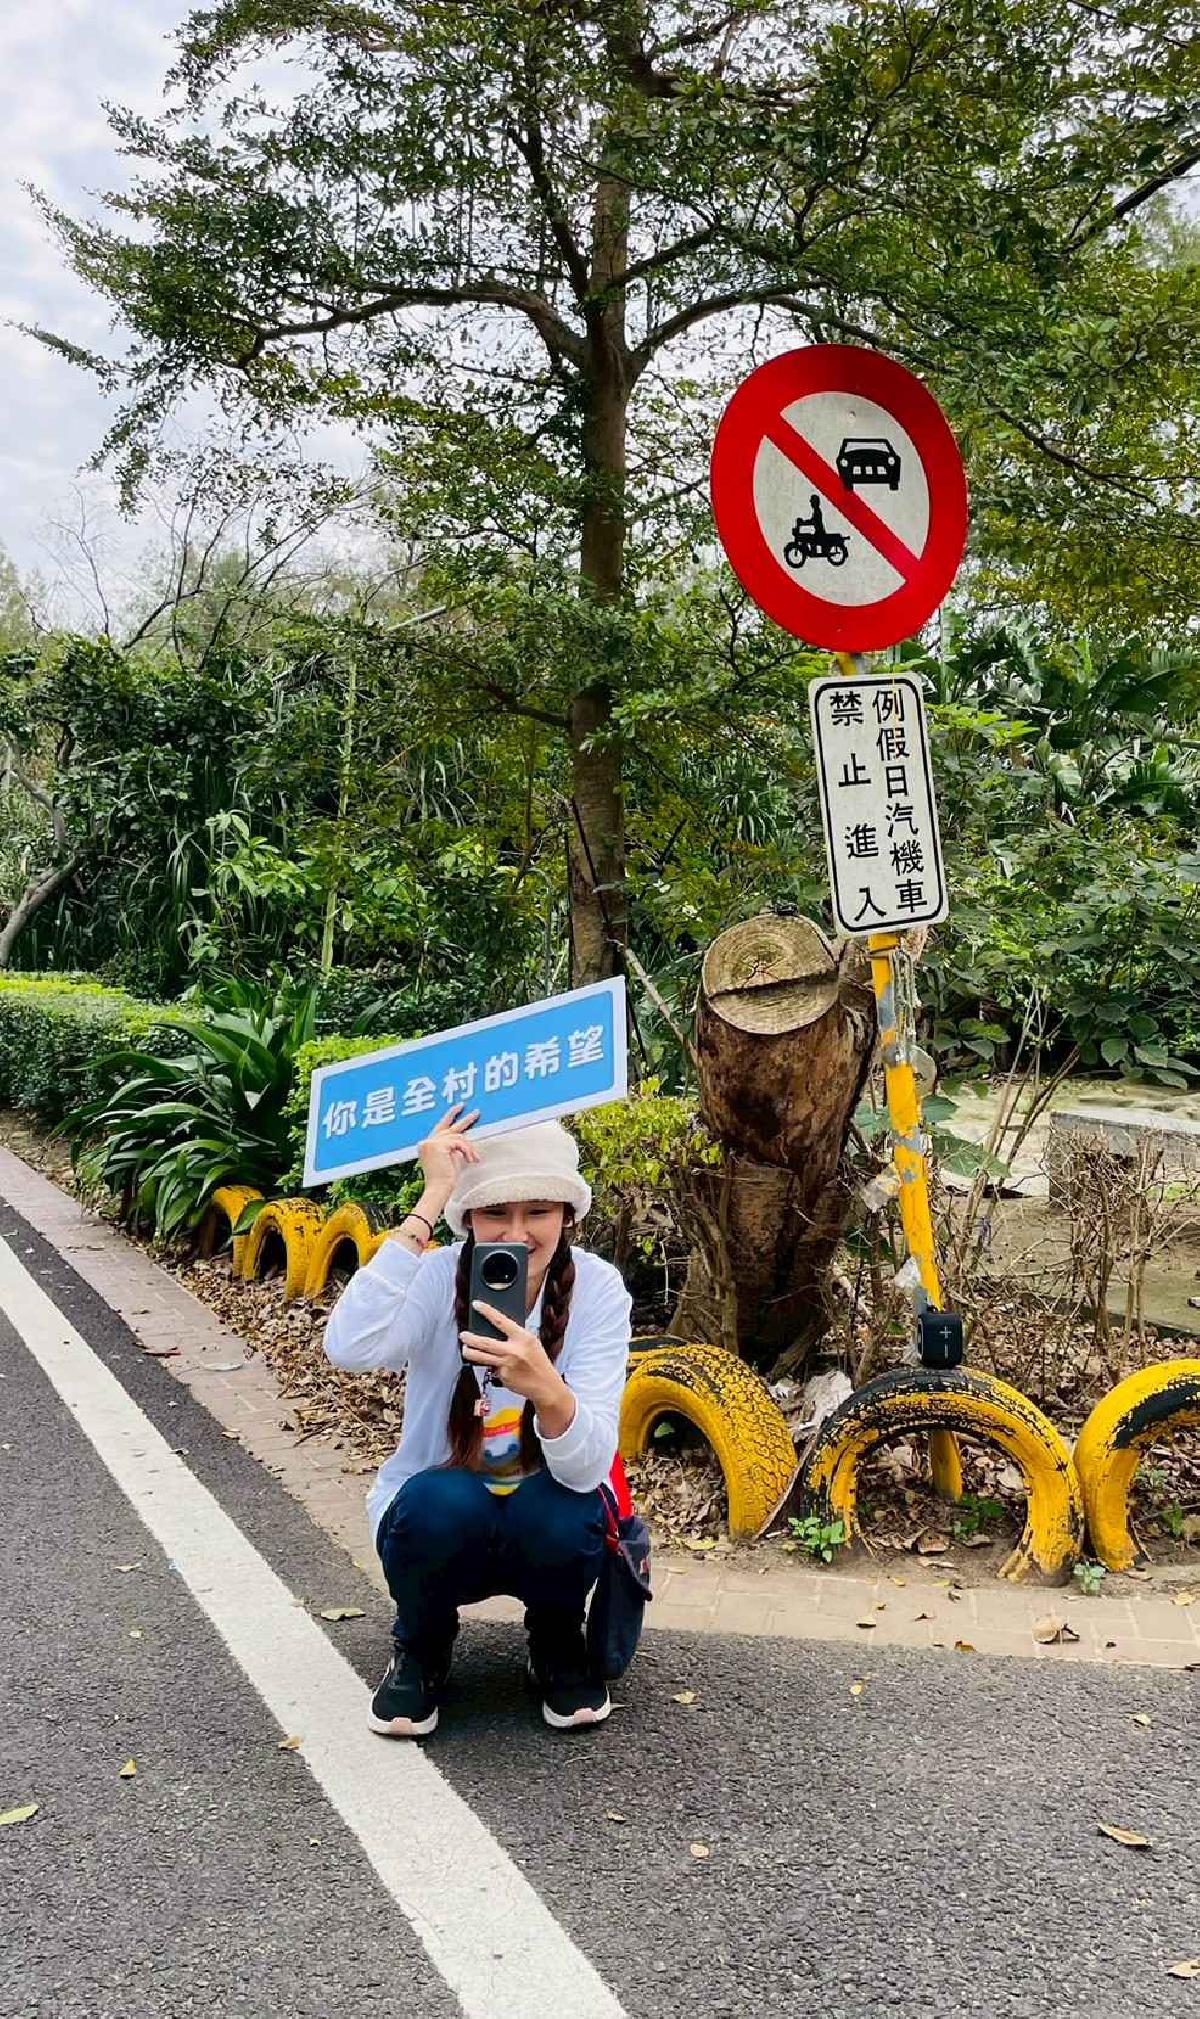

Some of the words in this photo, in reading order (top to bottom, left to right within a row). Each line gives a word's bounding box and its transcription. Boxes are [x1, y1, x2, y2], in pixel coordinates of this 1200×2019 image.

[830, 691, 887, 922] 禁止進入
[872, 689, 928, 913] 例假日汽機車
[321, 1023, 605, 1140] 你是全村的希望
